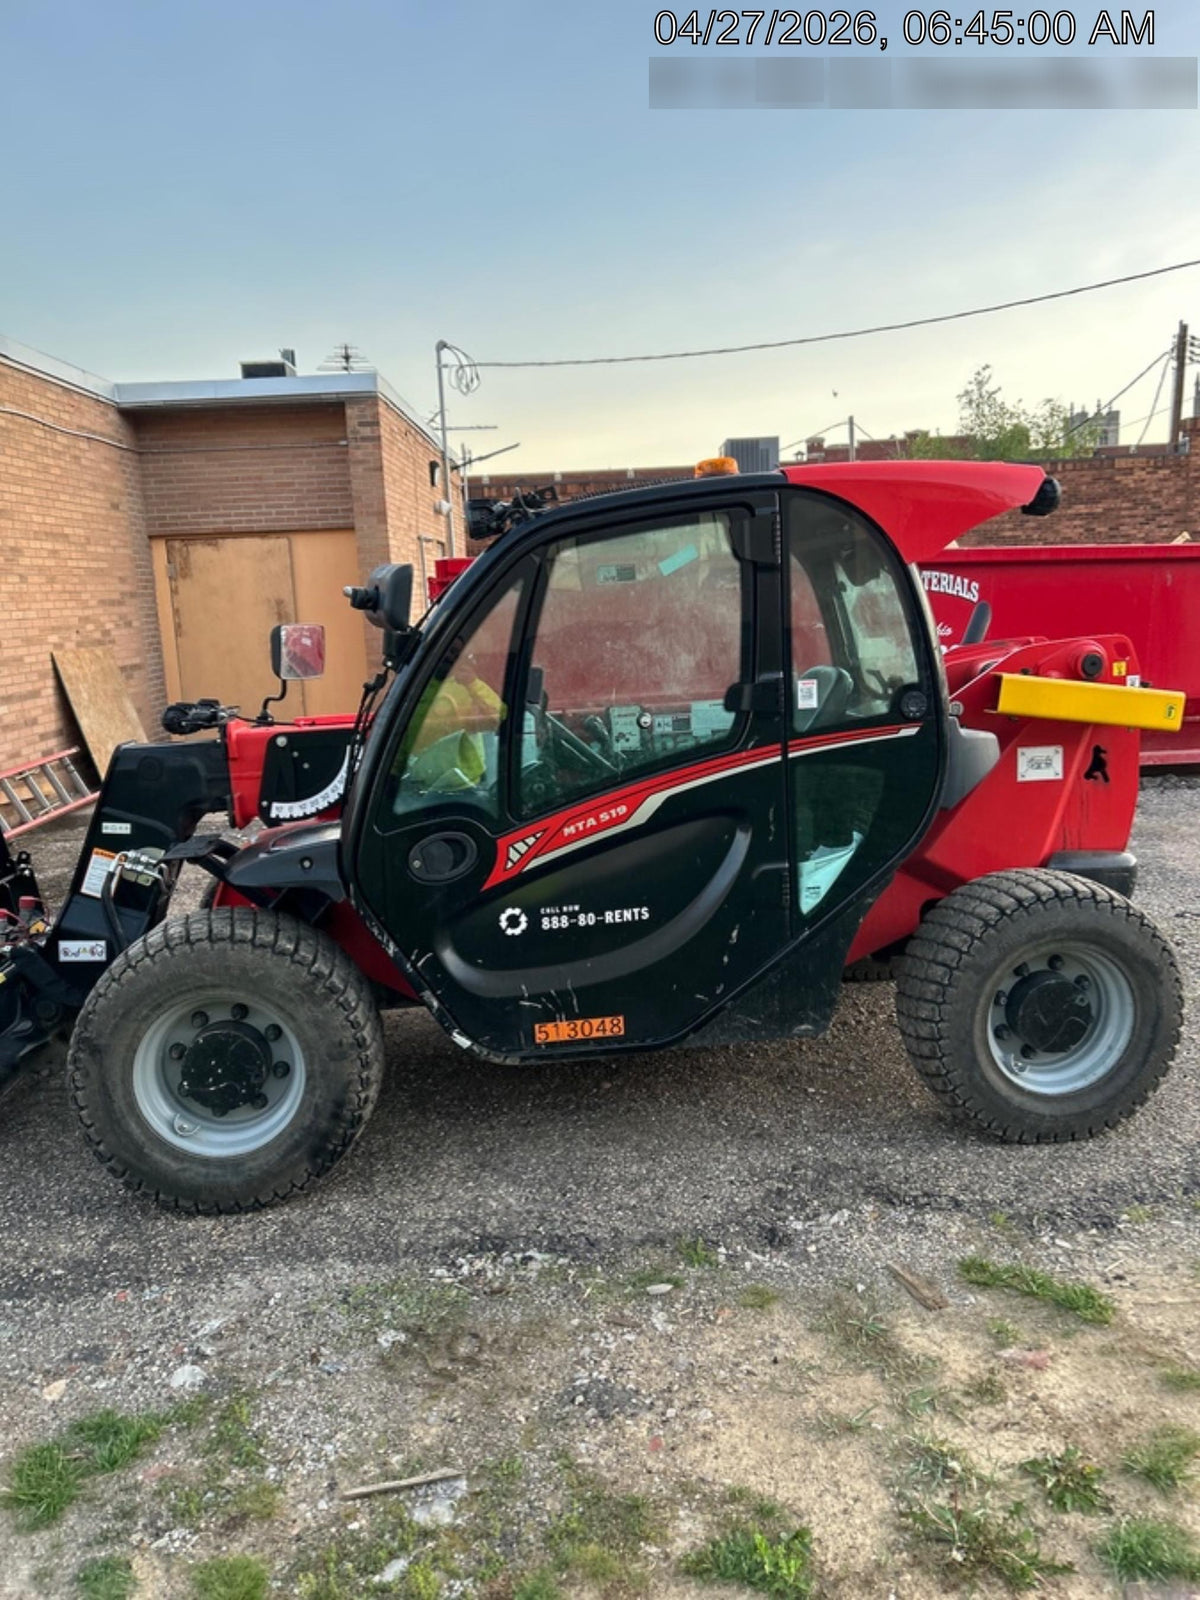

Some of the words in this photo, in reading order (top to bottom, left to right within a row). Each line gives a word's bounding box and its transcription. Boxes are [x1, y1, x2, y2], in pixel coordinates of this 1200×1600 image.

[921, 571, 979, 603] TERIALS
[563, 817, 597, 837] MTA
[541, 906, 650, 930] 888-80-RENTS
[538, 1017, 622, 1041] 513048
